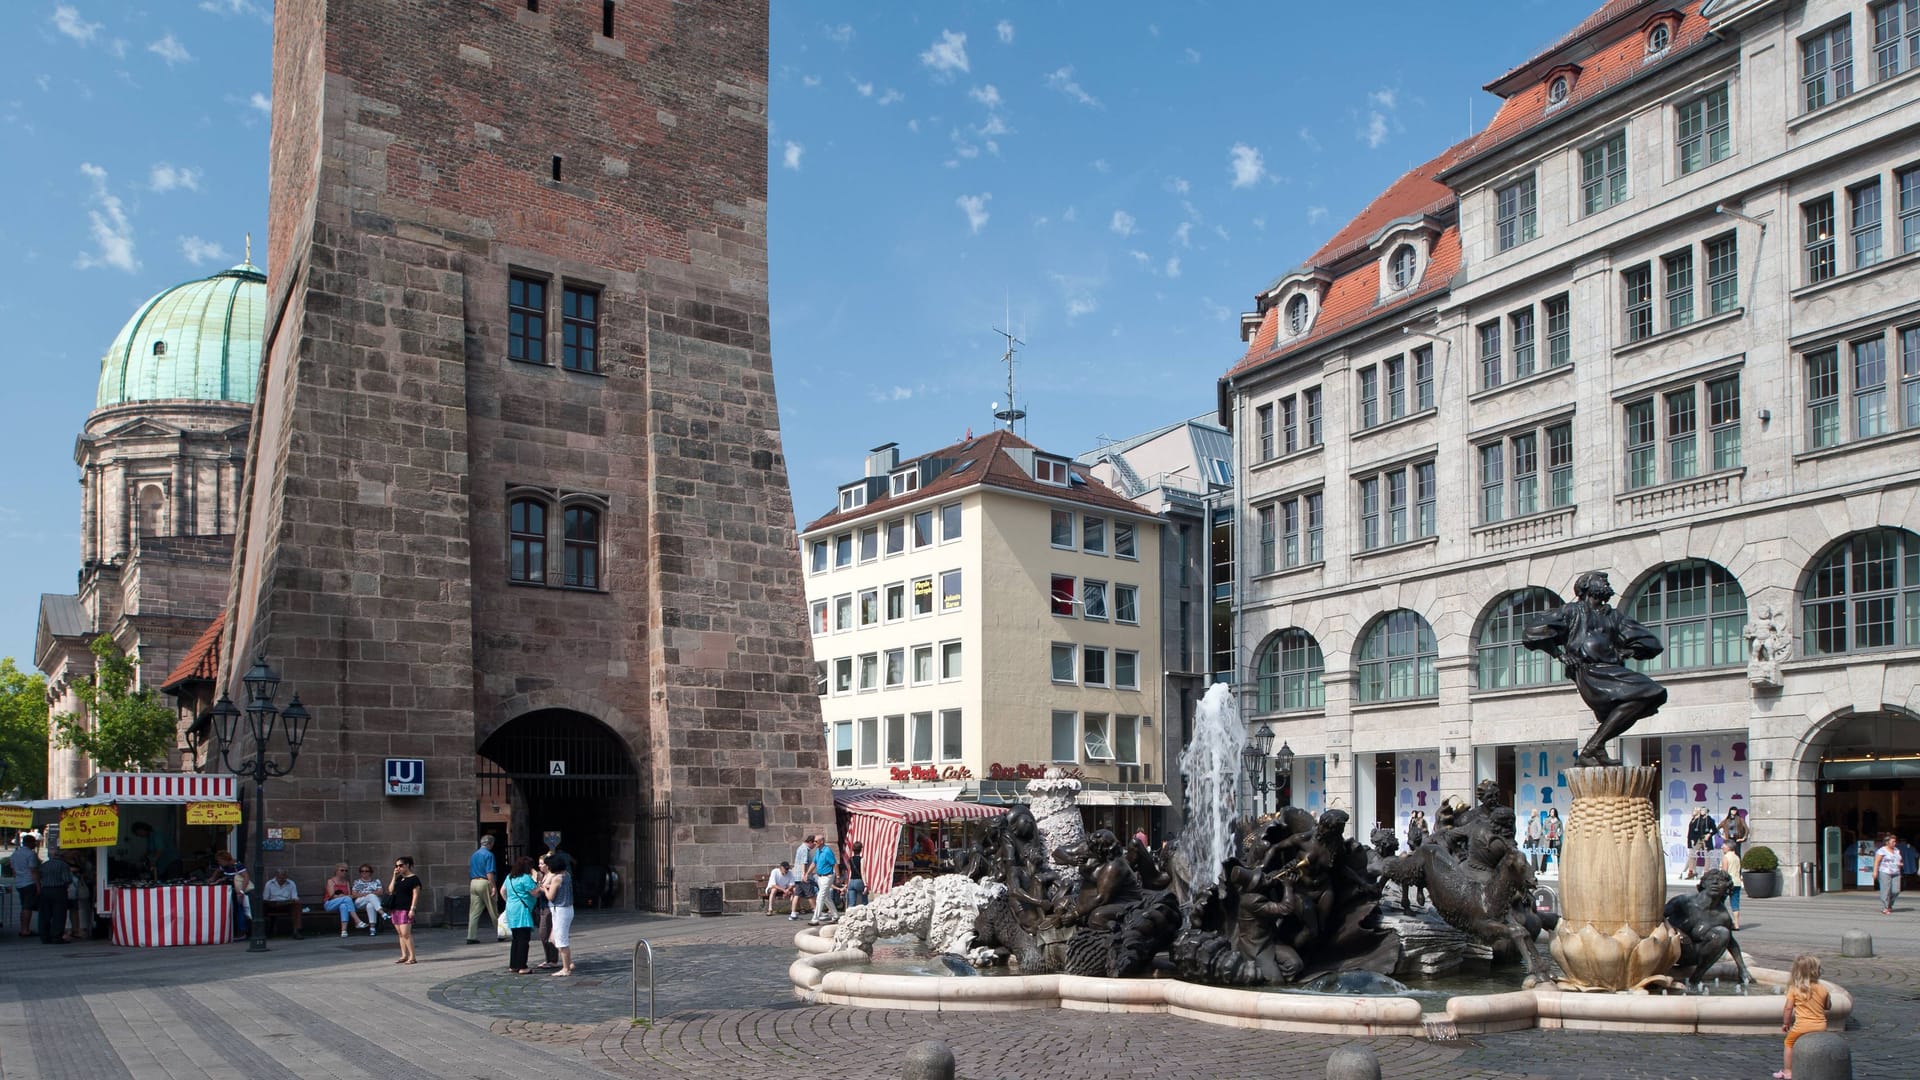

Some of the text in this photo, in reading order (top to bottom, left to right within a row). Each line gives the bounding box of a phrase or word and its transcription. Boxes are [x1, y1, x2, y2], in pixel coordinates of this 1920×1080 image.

[396, 761, 414, 782] U
[552, 763, 563, 774] A
[93, 808, 108, 816] Uhr
[98, 820, 116, 828] Euro
